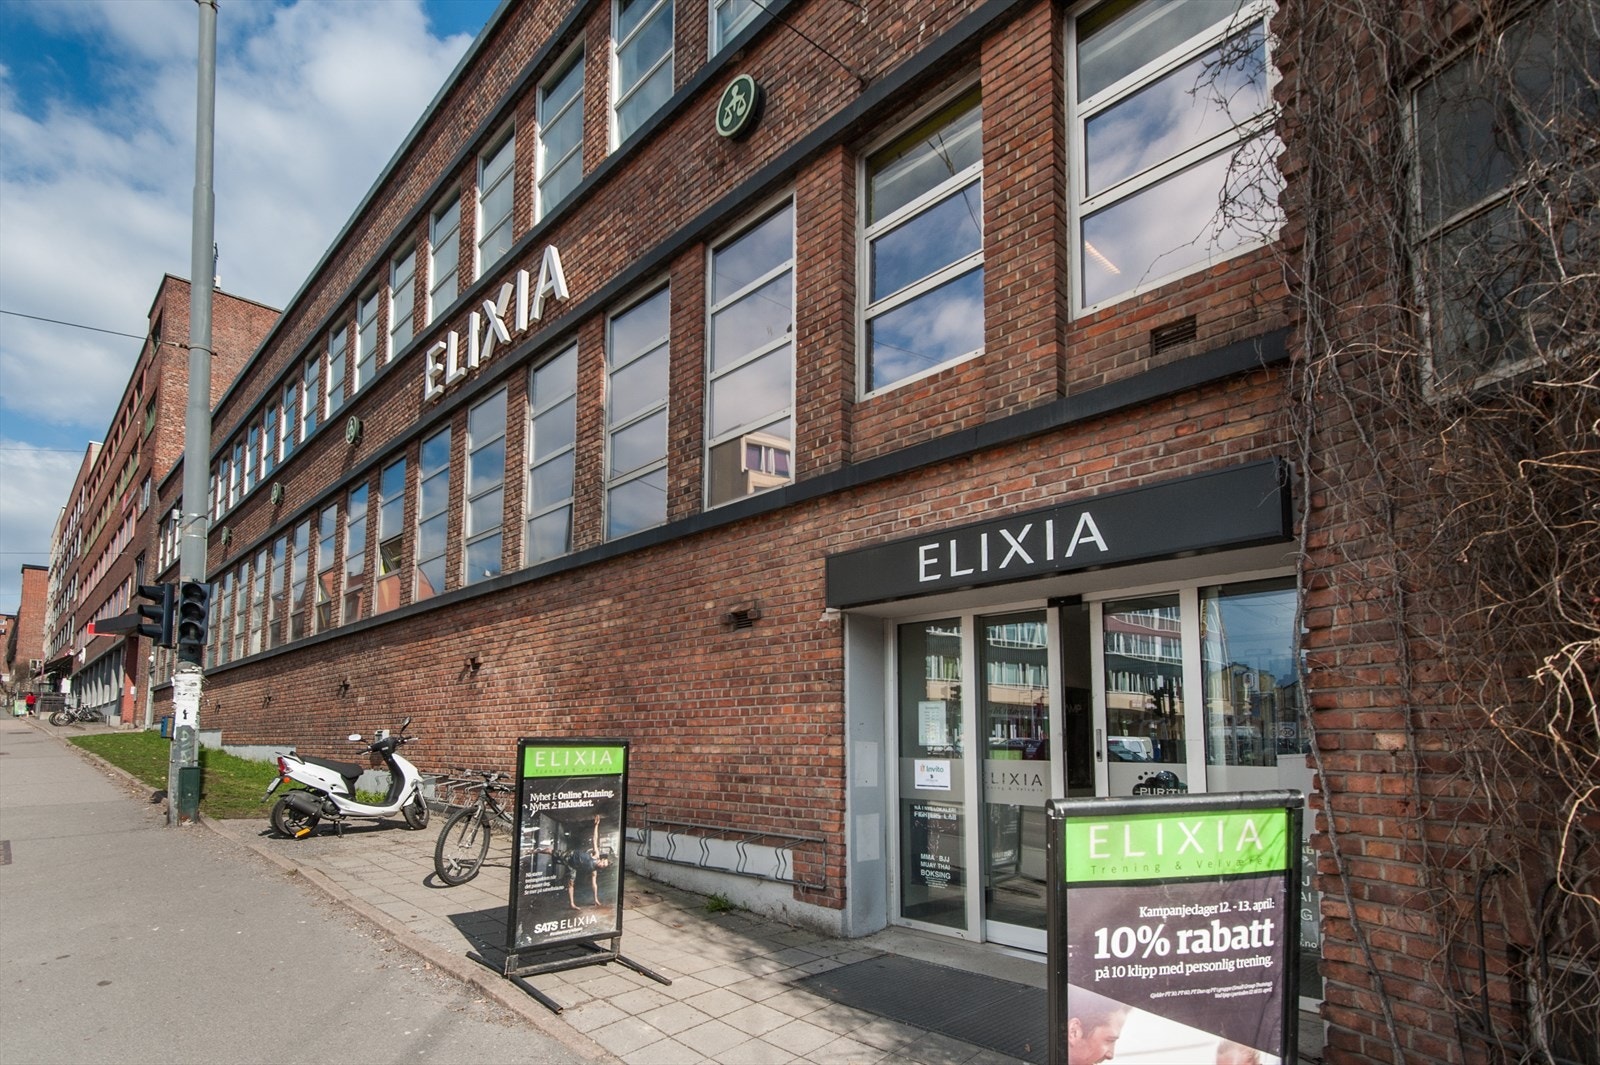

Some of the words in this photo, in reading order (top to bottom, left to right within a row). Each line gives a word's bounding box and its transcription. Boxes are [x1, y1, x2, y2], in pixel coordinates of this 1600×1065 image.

[424, 244, 570, 401] ELIXIA
[918, 511, 1109, 583] ELIXIA
[535, 750, 613, 768] ELIXIA
[984, 772, 1043, 787] LIXIA
[529, 793, 552, 803] Nyhet
[557, 790, 582, 800] Online
[529, 802, 551, 813] Nyhet
[557, 799, 594, 810] Inkludert.
[1089, 818, 1263, 859] ELIXIA
[920, 853, 935, 861] MMA
[938, 855, 950, 863] BJJ
[920, 861, 936, 869] MUAY
[937, 863, 951, 871] THAI
[1091, 863, 1161, 874] Trening
[1175, 860, 1183, 870] &
[920, 869, 951, 880] BOKSING
[1139, 903, 1218, 919] Kampanjedager
[1219, 902, 1231, 913] 12.
[1238, 901, 1252, 912] 13.
[1252, 898, 1275, 912] april:
[534, 920, 559, 934] SATS
[560, 914, 598, 930] ELIXIA
[1094, 923, 1171, 960] 10%
[1176, 918, 1275, 955] rabatt
[1095, 966, 1110, 981] på
[1112, 965, 1126, 978] 10
[1127, 963, 1158, 979] klipp
[1159, 961, 1184, 975] med
[1185, 958, 1235, 976] personlig
[1236, 954, 1273, 968] trening.
